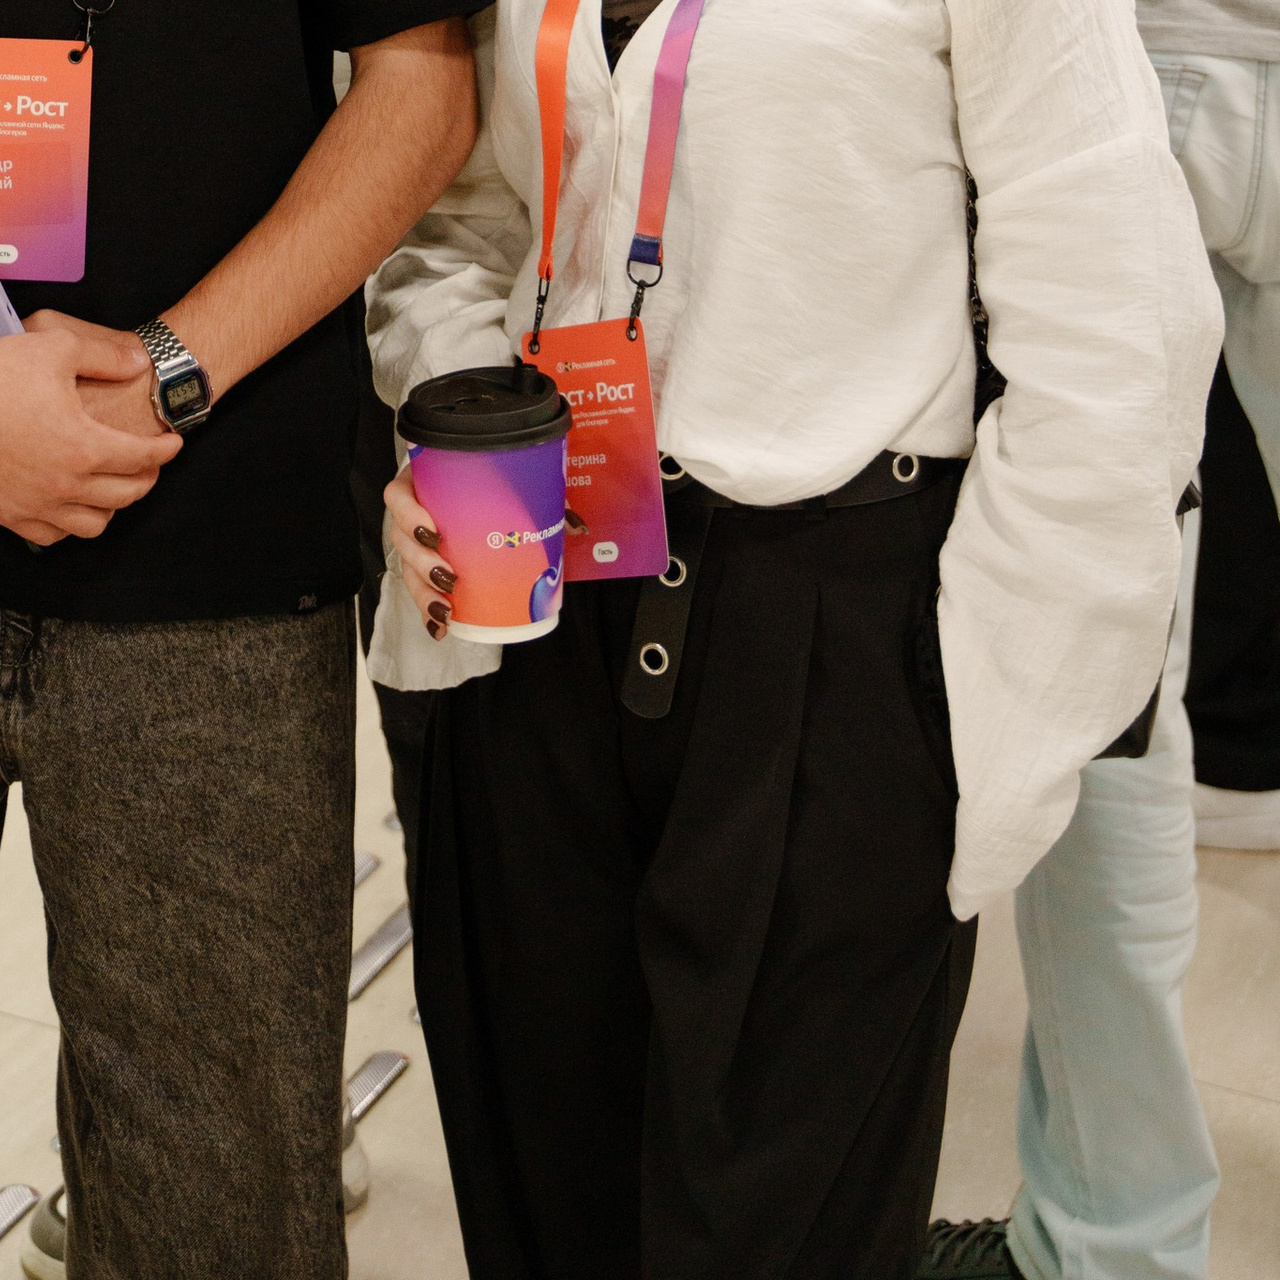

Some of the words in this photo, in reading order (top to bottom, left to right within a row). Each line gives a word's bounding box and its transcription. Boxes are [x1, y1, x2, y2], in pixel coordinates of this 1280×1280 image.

[31, 74, 48, 82] сеть
[16, 95, 69, 117] Рост
[559, 389, 585, 407] ст
[595, 382, 635, 403] Рост
